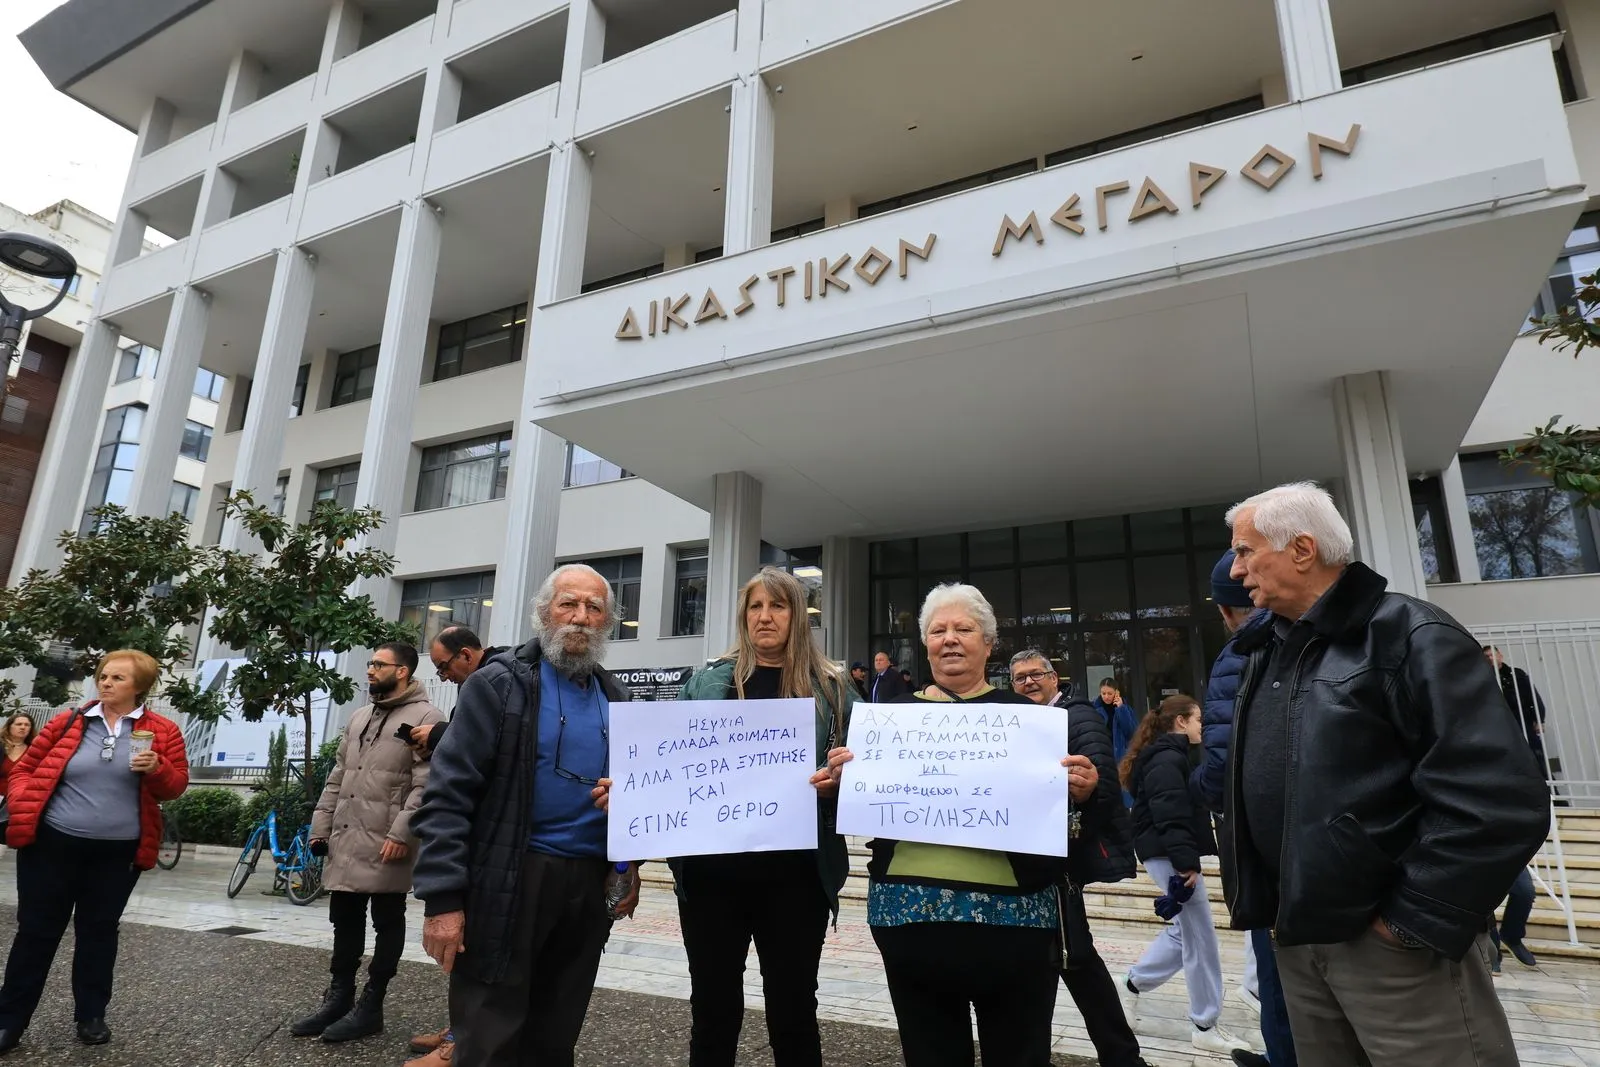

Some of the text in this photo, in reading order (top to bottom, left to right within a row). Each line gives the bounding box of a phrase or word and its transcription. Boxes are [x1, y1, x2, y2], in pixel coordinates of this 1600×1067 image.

[614, 123, 1362, 341] ΔΙΚΑΣΤΙΚΟΝ ΜΕΓΑΡΟΝ
[688, 715, 744, 735] ΗΣΥΧΙΑ
[859, 709, 1021, 729] ΑΧ ΕΛΛΑΔΑ
[628, 727, 796, 758] Η ΕΛΛΑΔΑ ΚΟΙΜΑΤΑΙ
[865, 729, 1008, 745] ΟΙ ΑΓΡΑΜΜΑΤΟΙ
[861, 748, 1009, 762] ΣΕ ΕΛΕΥΘΕΡΩΣΑΝ
[624, 748, 806, 792] ΑΛΛΑ ΤΩΡΑ ΞΥΠΝΗΣΕ
[922, 764, 946, 775] ΚΑΙ
[689, 781, 725, 804] ΚΑΙ
[854, 781, 993, 797] ΟΙ ΜΟΡΦΩΜΕΝΟΙ ΣΕ
[629, 802, 779, 837] ΕΓΙΝΕ ΘΕΡΙΟ
